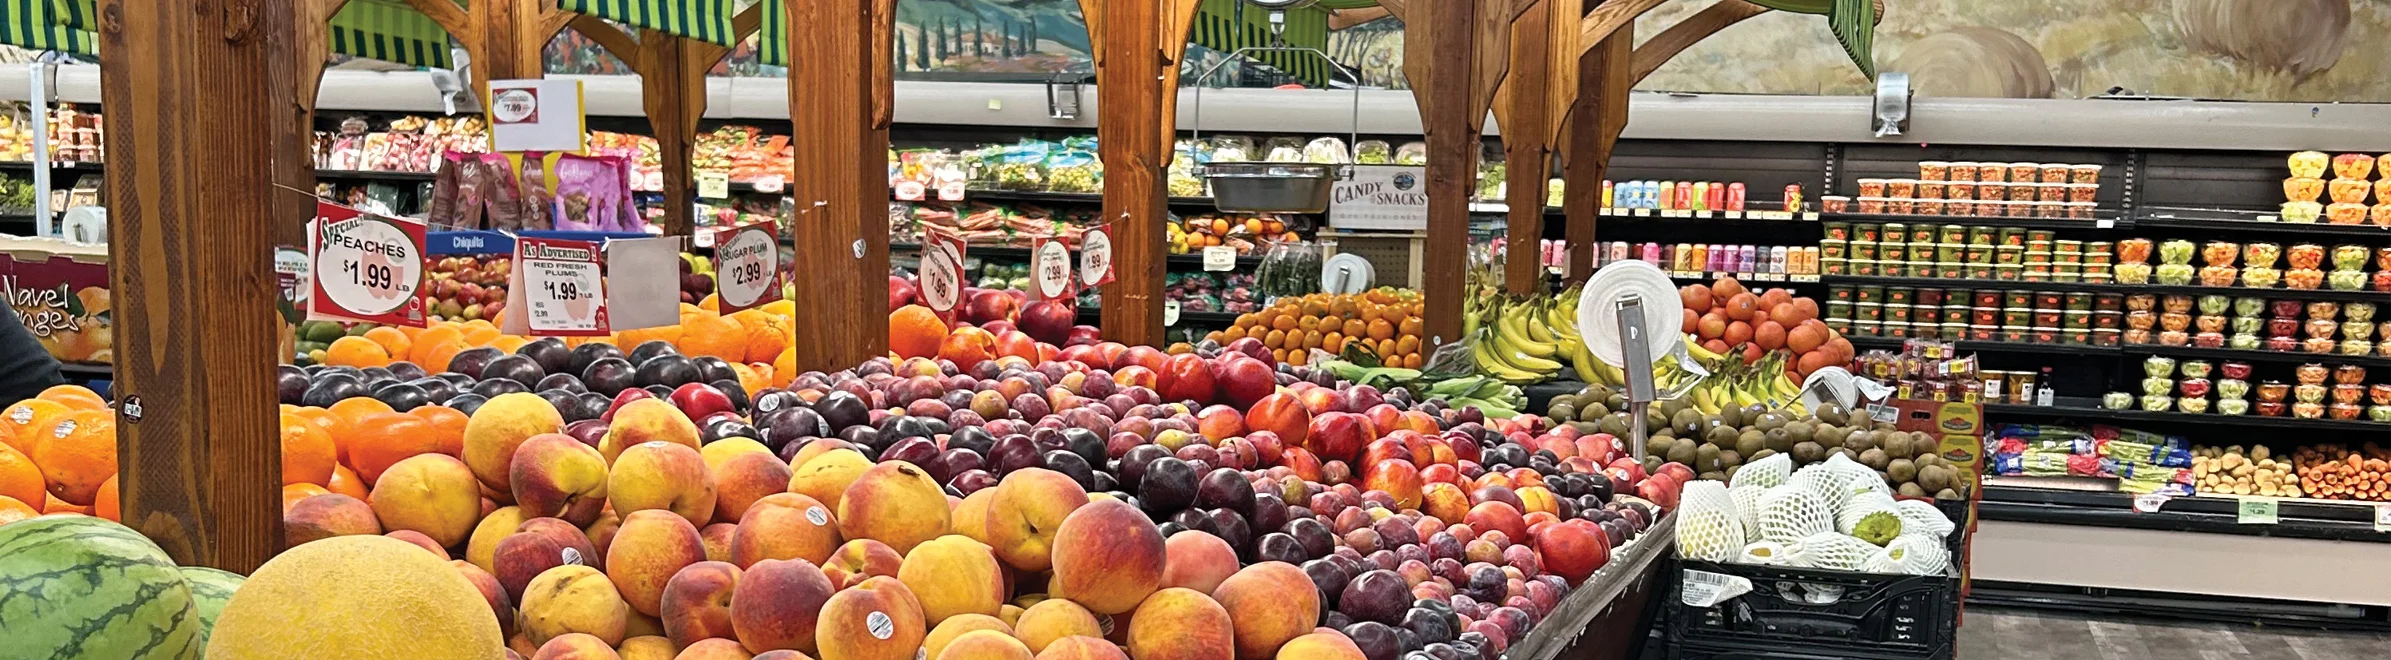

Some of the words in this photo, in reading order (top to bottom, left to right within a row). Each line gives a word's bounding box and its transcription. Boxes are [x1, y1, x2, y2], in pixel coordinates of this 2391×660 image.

[1335, 182, 1384, 204] CANDY
[1376, 192, 1426, 206] SNACKS
[333, 233, 407, 259] PEACHES
[453, 235, 484, 252] Chiquita
[748, 242, 768, 258] PLUM
[343, 258, 392, 290] $1.99
[533, 261, 554, 269] RED
[544, 269, 578, 277] PLUMS
[732, 261, 761, 286] $2.99
[2, 274, 70, 309] Navel
[395, 283, 411, 293] LB
[543, 279, 577, 301] $1.99
[929, 268, 947, 299] $1.99
[18, 309, 80, 338] nges
